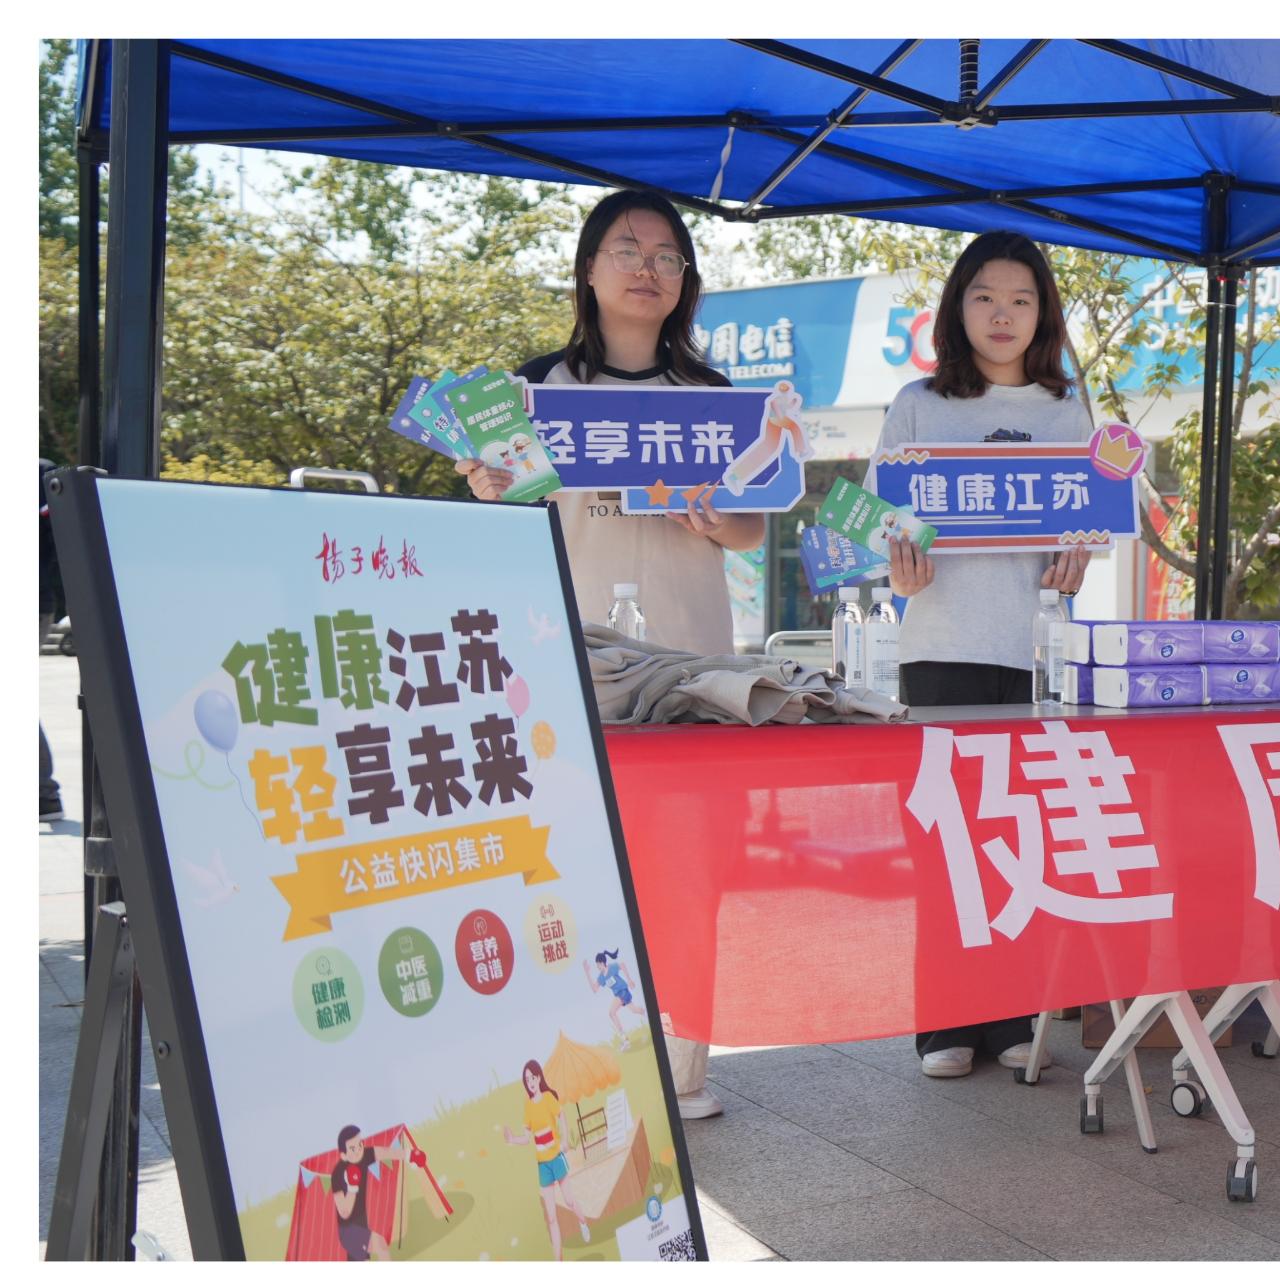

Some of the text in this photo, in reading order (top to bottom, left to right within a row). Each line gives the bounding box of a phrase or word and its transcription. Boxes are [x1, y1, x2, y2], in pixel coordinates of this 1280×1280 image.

[534, 420, 735, 465] 轻享未来
[908, 472, 1091, 512] 健康江苏
[588, 504, 609, 518] TO
[221, 608, 514, 727] 健康江苏
[248, 712, 534, 846] 轻享未来
[339, 832, 506, 895] 公益快闪集市
[537, 919, 566, 943] 运动
[469, 936, 500, 961] 营养
[542, 940, 570, 965] 挑战
[396, 954, 429, 982] 中医
[475, 958, 504, 985] 食谱
[311, 976, 347, 1006] 健康
[400, 979, 434, 1007] 减重
[315, 1000, 352, 1031] 检测
